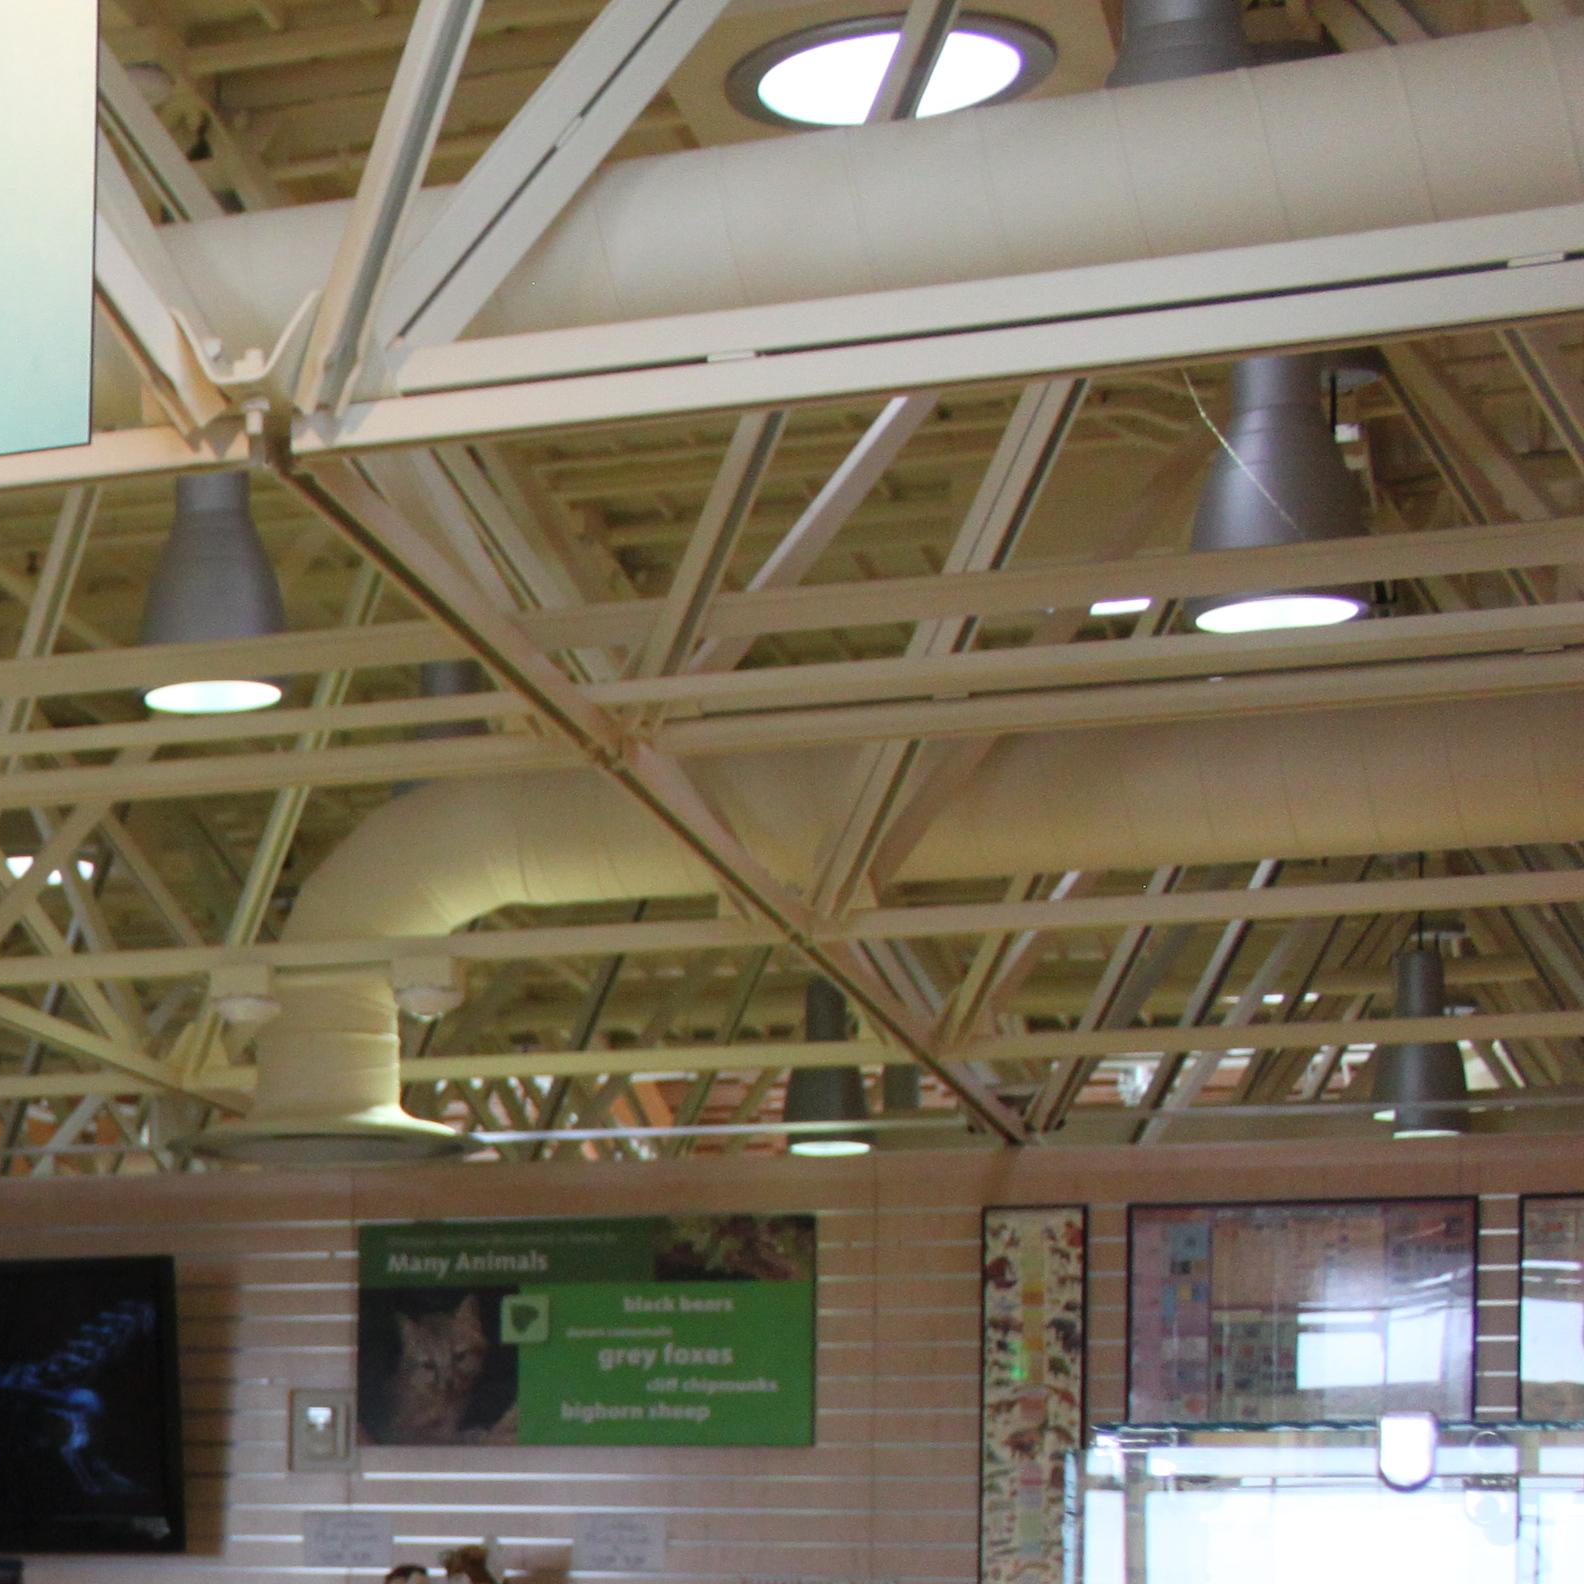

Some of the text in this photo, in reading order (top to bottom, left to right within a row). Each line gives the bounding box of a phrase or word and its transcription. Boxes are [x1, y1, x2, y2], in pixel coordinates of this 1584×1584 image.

[387, 1248, 548, 1279] Many Animals
[597, 1343, 734, 1371] grey foxes
